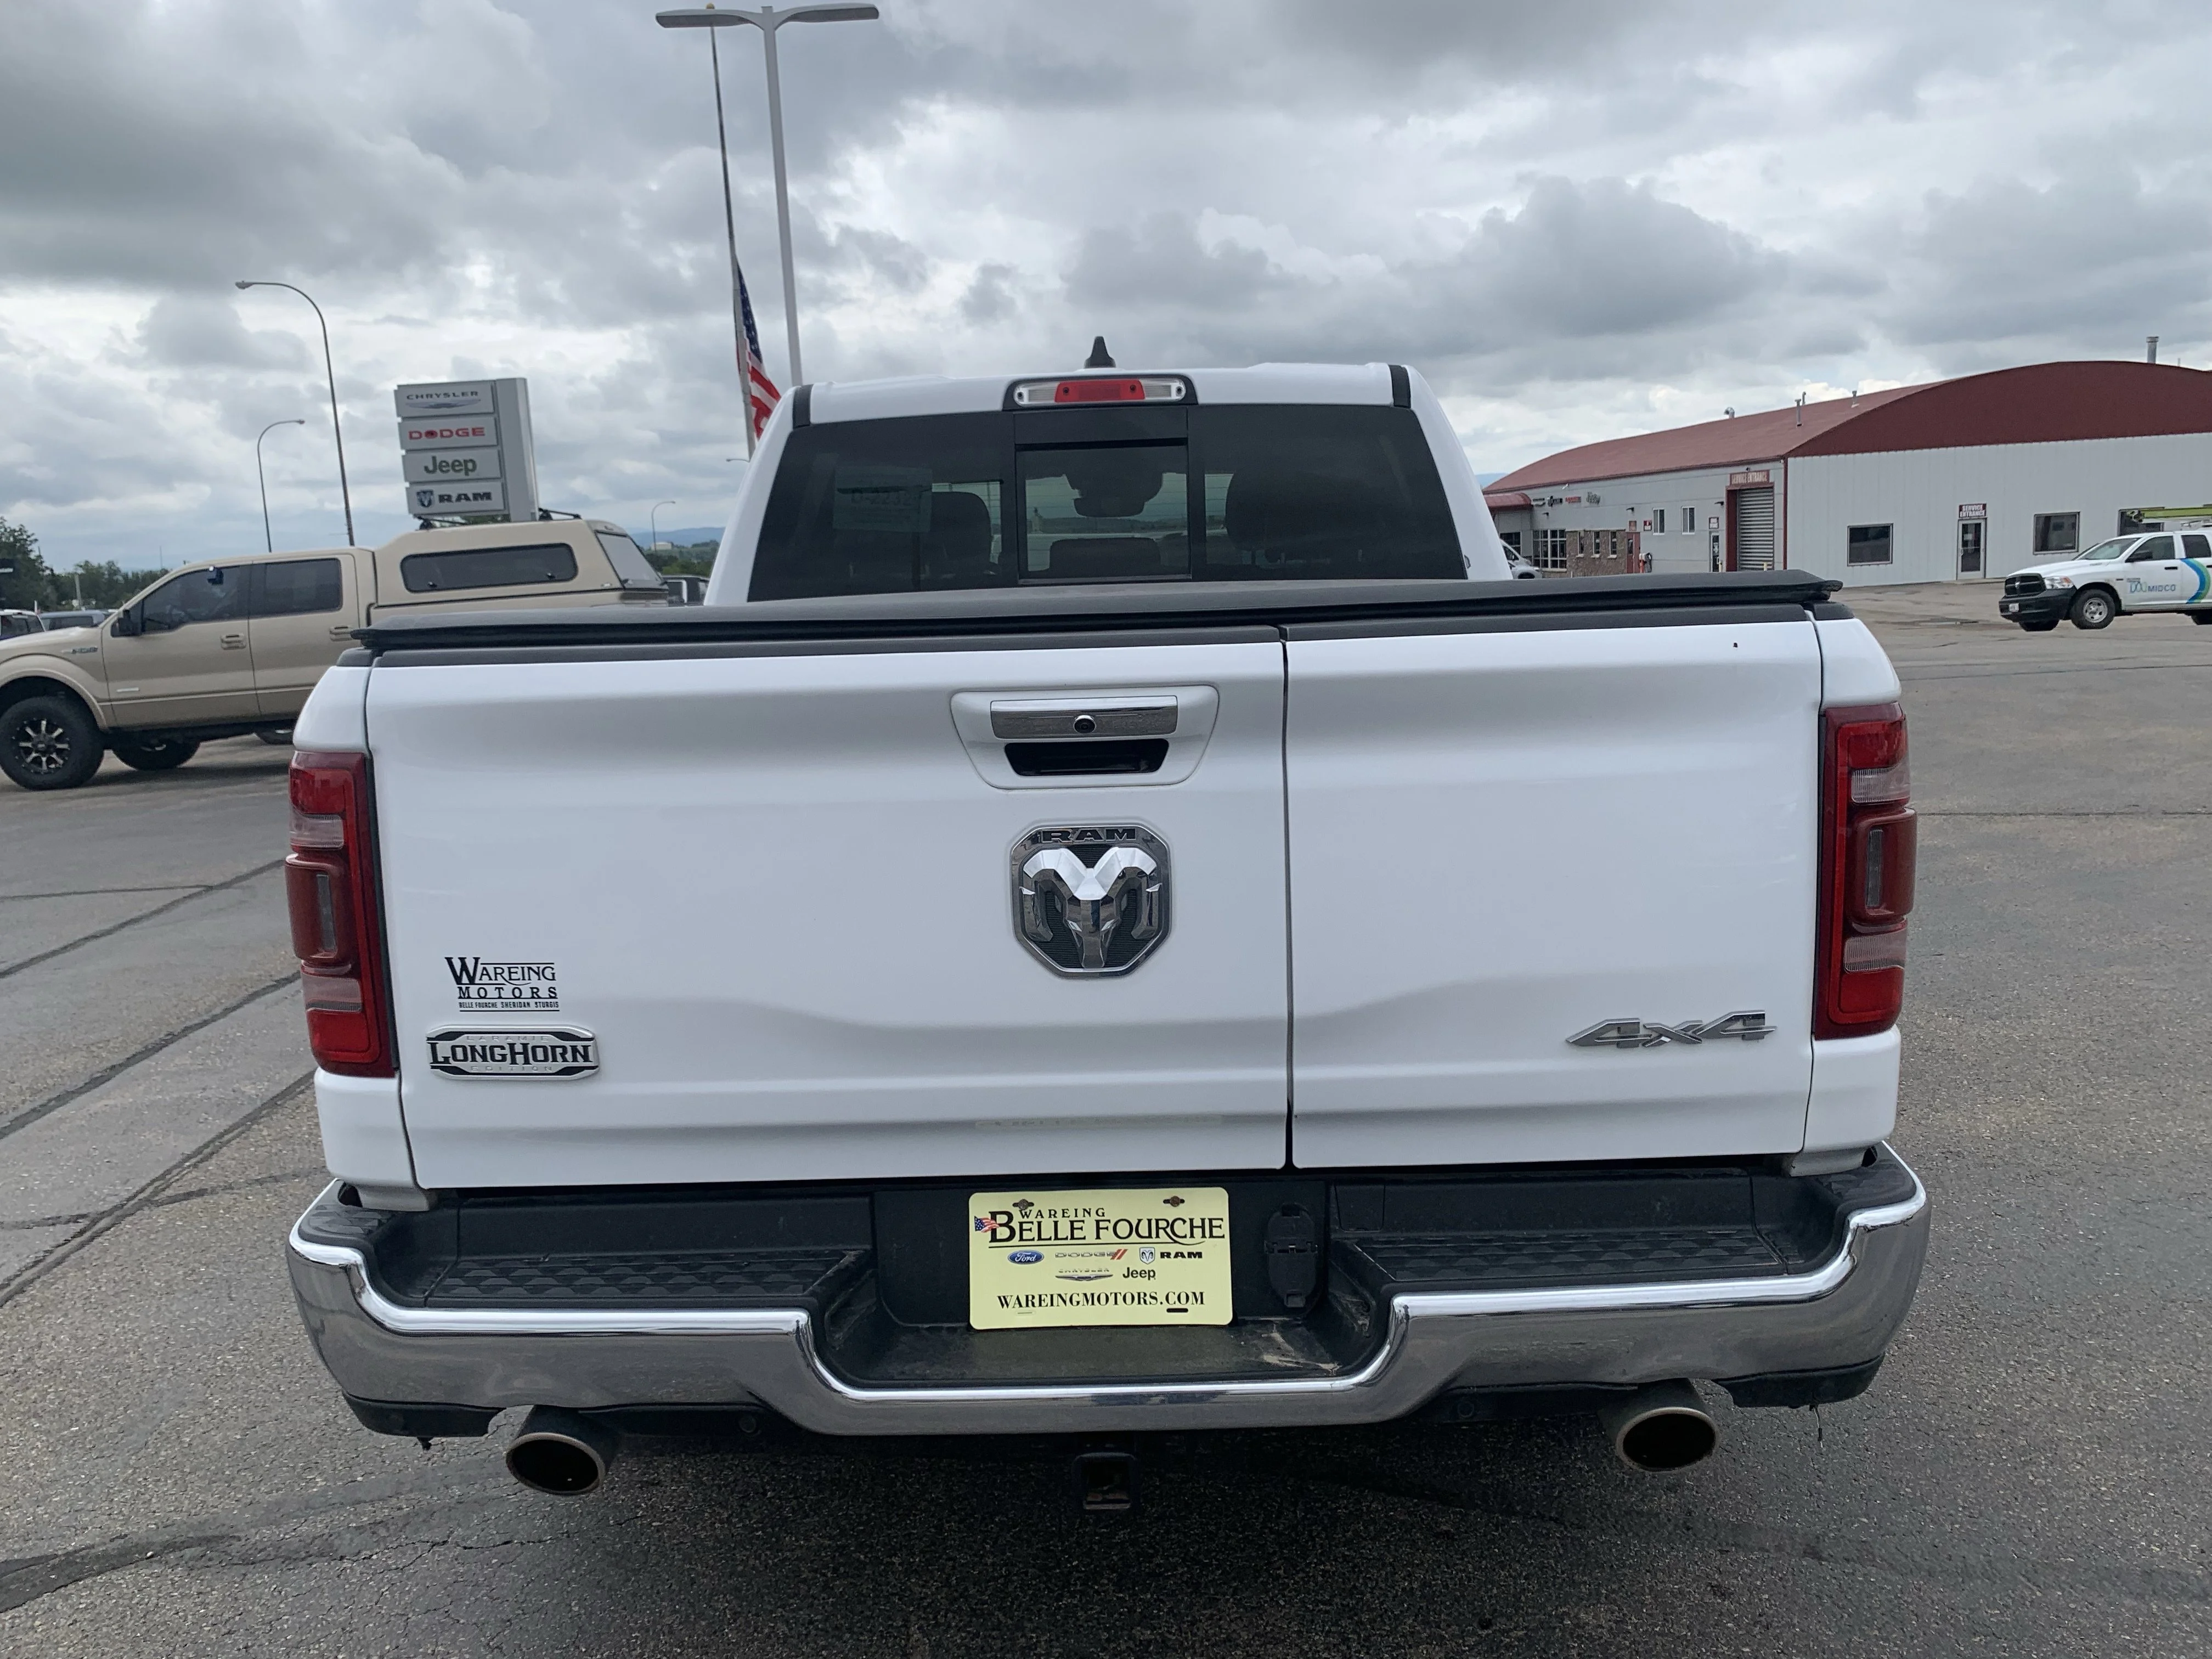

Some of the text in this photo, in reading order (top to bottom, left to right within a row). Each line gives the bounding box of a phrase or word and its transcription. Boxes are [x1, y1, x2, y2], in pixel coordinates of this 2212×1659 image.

[407, 391, 479, 400] CHRYSLER
[408, 427, 486, 440] DODGE
[424, 455, 477, 476] Jeep
[438, 492, 492, 504] RAM
[1042, 827, 1137, 843] RAM
[444, 957, 557, 986] WAREING
[457, 986, 558, 999] MOTORS
[1019, 1207, 1105, 1219] WAREING
[989, 1211, 1225, 1245] BELLE FOURCHE
[1014, 1252, 1037, 1262] Ford
[1122, 1267, 1156, 1280] Jeep
[997, 1291, 1205, 1309] WAREINGMOTORS.COM
